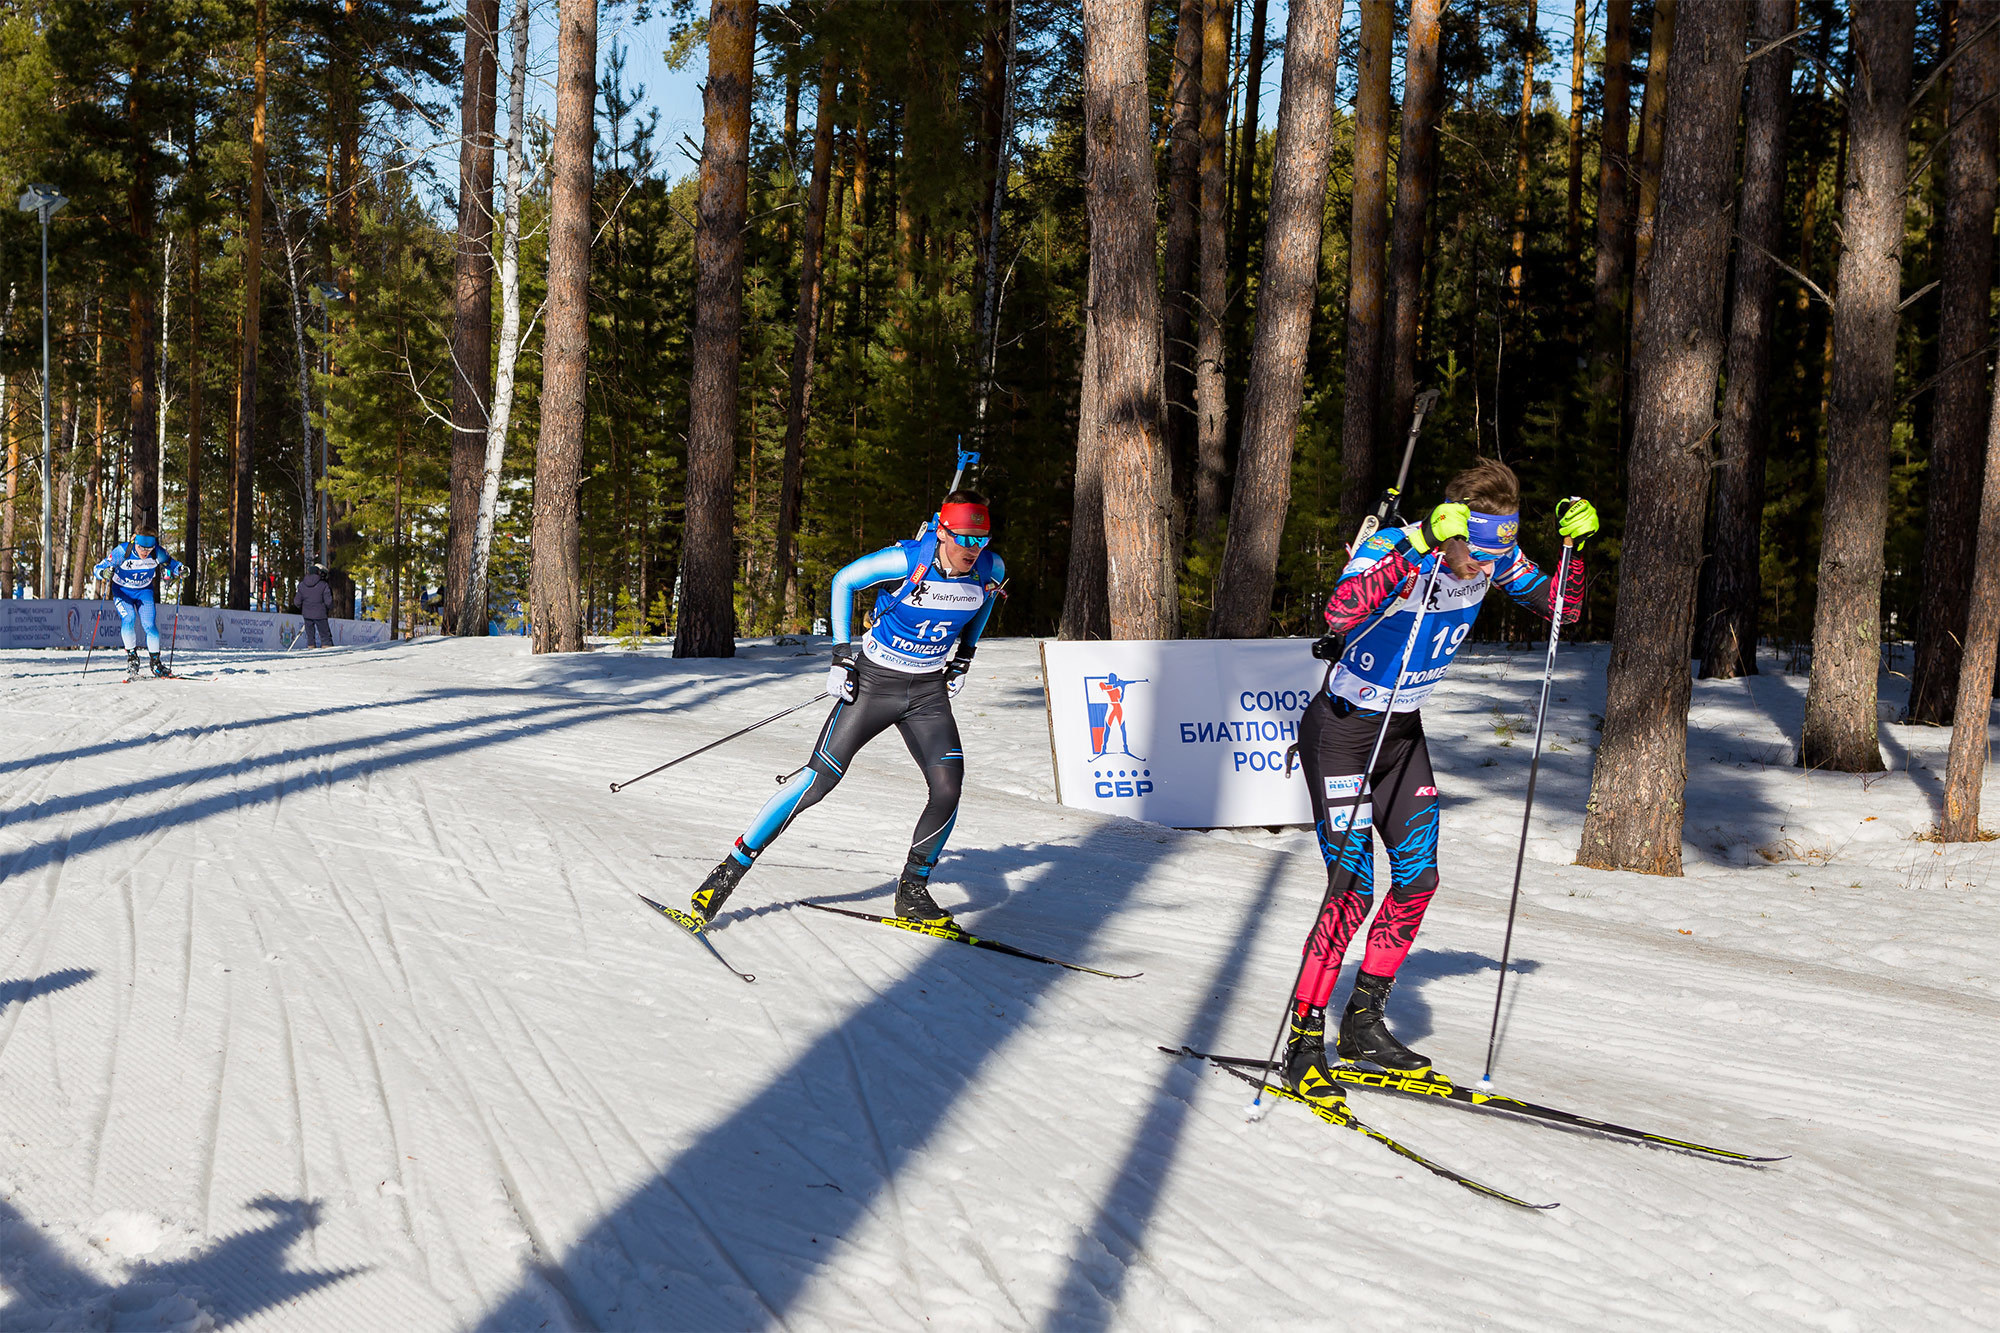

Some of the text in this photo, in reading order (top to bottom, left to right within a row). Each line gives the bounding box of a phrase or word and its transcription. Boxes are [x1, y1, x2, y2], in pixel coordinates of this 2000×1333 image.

[132, 571, 148, 580] 17
[932, 593, 977, 603] VisitTyumen
[915, 619, 953, 643] 15
[1432, 623, 1470, 660] 19
[891, 635, 947, 654] ТЮМЕНЬ
[1349, 645, 1375, 671] 19
[1240, 690, 1311, 712] СОЮЗ
[1095, 780, 1154, 798] СБР
[881, 917, 960, 941] FISCHER
